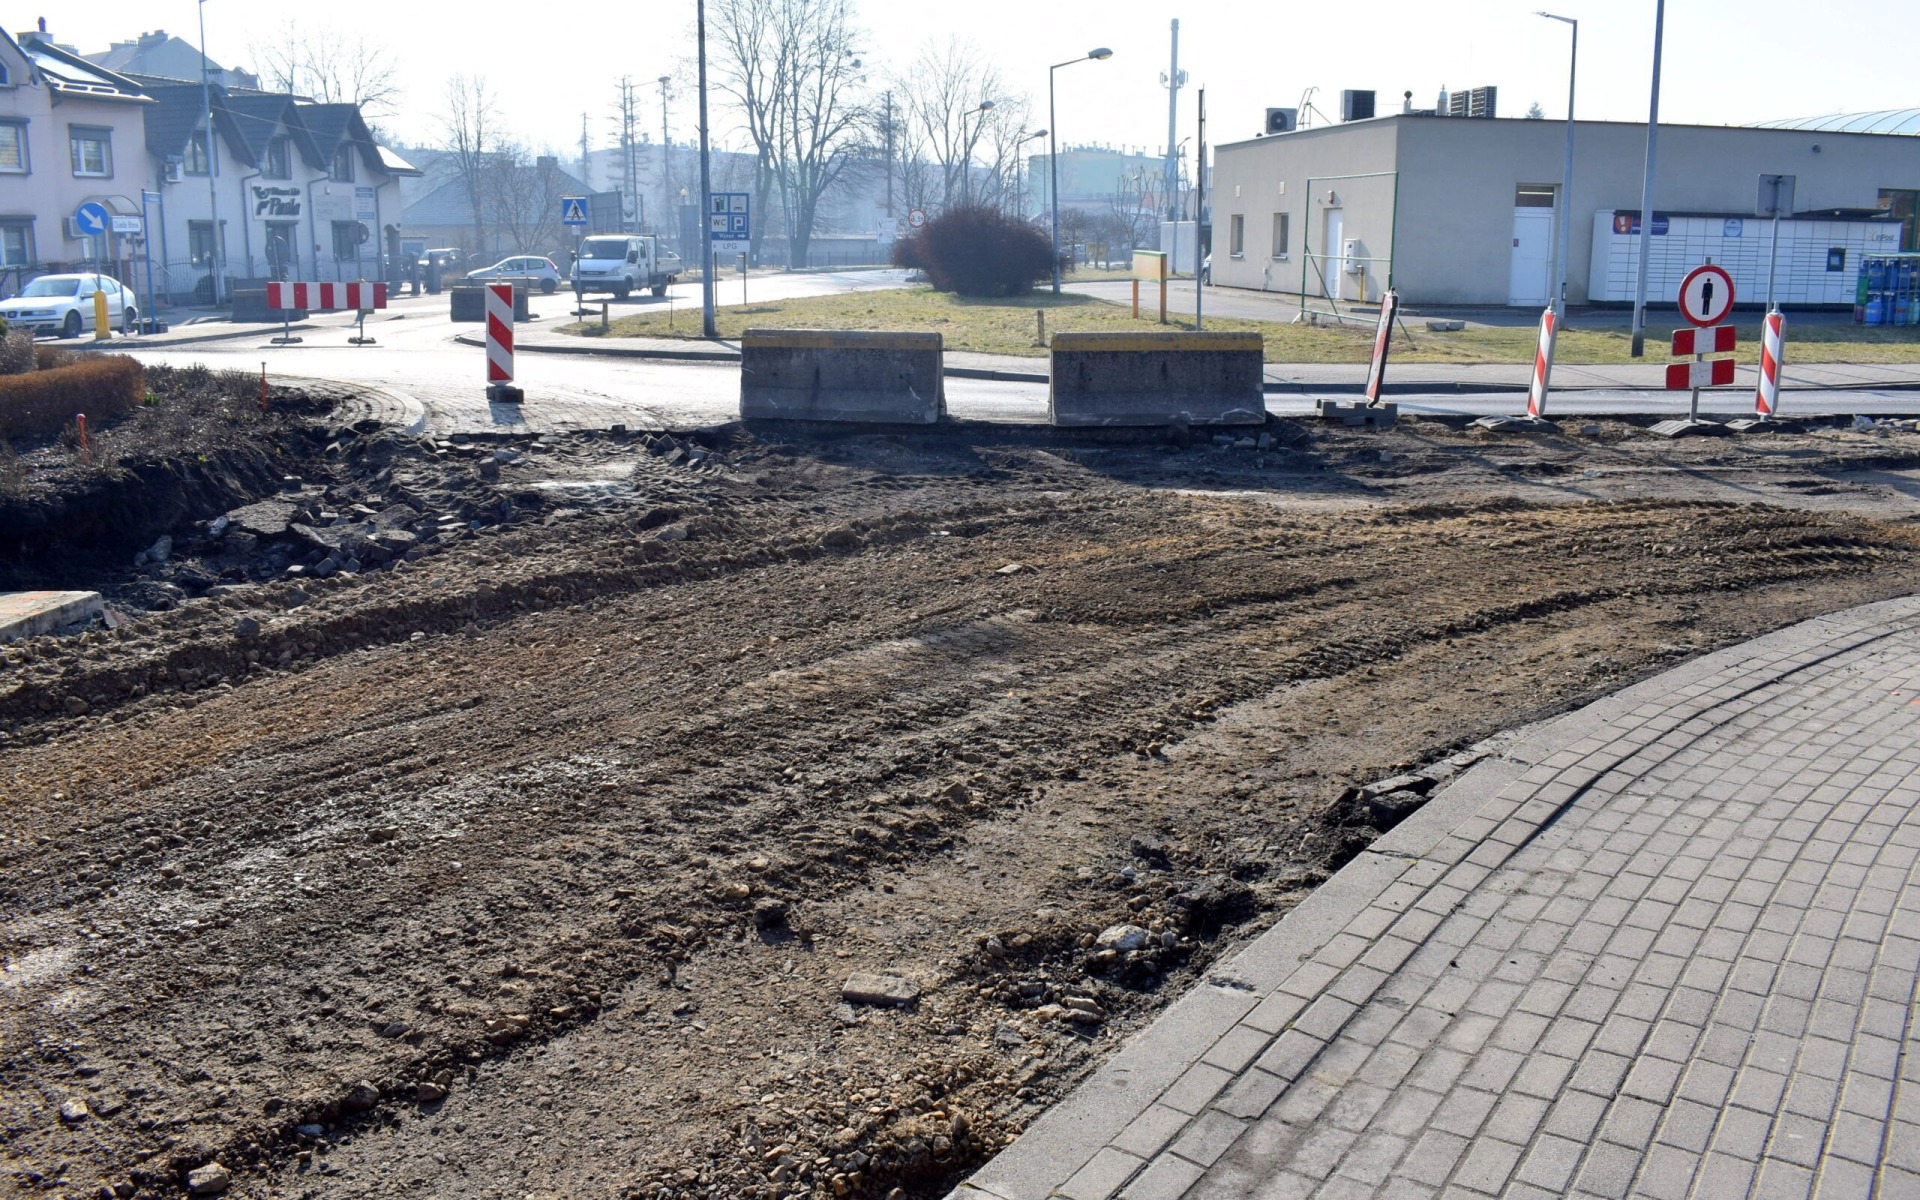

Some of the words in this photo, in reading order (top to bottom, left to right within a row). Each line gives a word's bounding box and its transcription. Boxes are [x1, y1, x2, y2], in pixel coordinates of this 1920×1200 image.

[712, 218, 727, 226] WC
[733, 217, 744, 230] P
[1875, 232, 1895, 241] InPost
[722, 242, 738, 250] LPG
